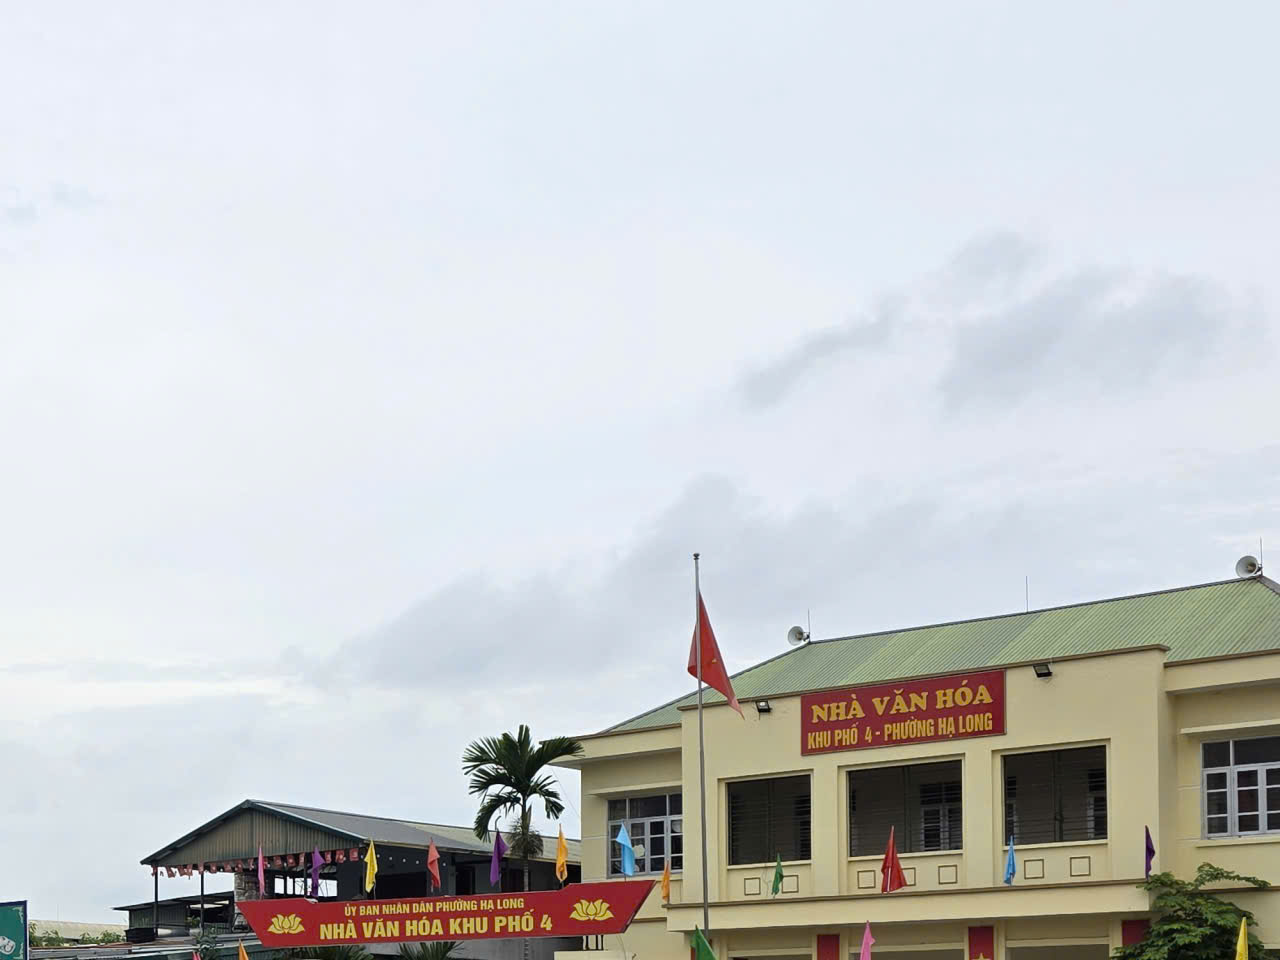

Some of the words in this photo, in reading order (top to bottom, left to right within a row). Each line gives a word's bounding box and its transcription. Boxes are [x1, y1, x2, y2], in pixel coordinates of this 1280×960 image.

[811, 693, 866, 723] NHÀ
[872, 688, 928, 716] VĂN
[935, 680, 993, 709] HÓA
[807, 731, 831, 750] KHU
[834, 722, 859, 747] PHỐ
[864, 726, 872, 743] 4
[884, 716, 935, 741] PHƯỜNG
[938, 716, 956, 738] HẠ
[958, 712, 993, 733] LONG
[320, 917, 358, 940] NHÀ
[362, 917, 400, 938] VĂN
[405, 915, 443, 936] HÓA
[449, 916, 488, 935] KHU
[494, 908, 534, 933] PHỐ
[540, 914, 552, 931] 4
[360, 904, 380, 916] BAN
[382, 902, 410, 915] NHÂN
[413, 900, 433, 914] DÂN
[436, 898, 477, 912] PHƯỜNG
[480, 899, 495, 913] HẠ
[497, 897, 524, 909] LONG
